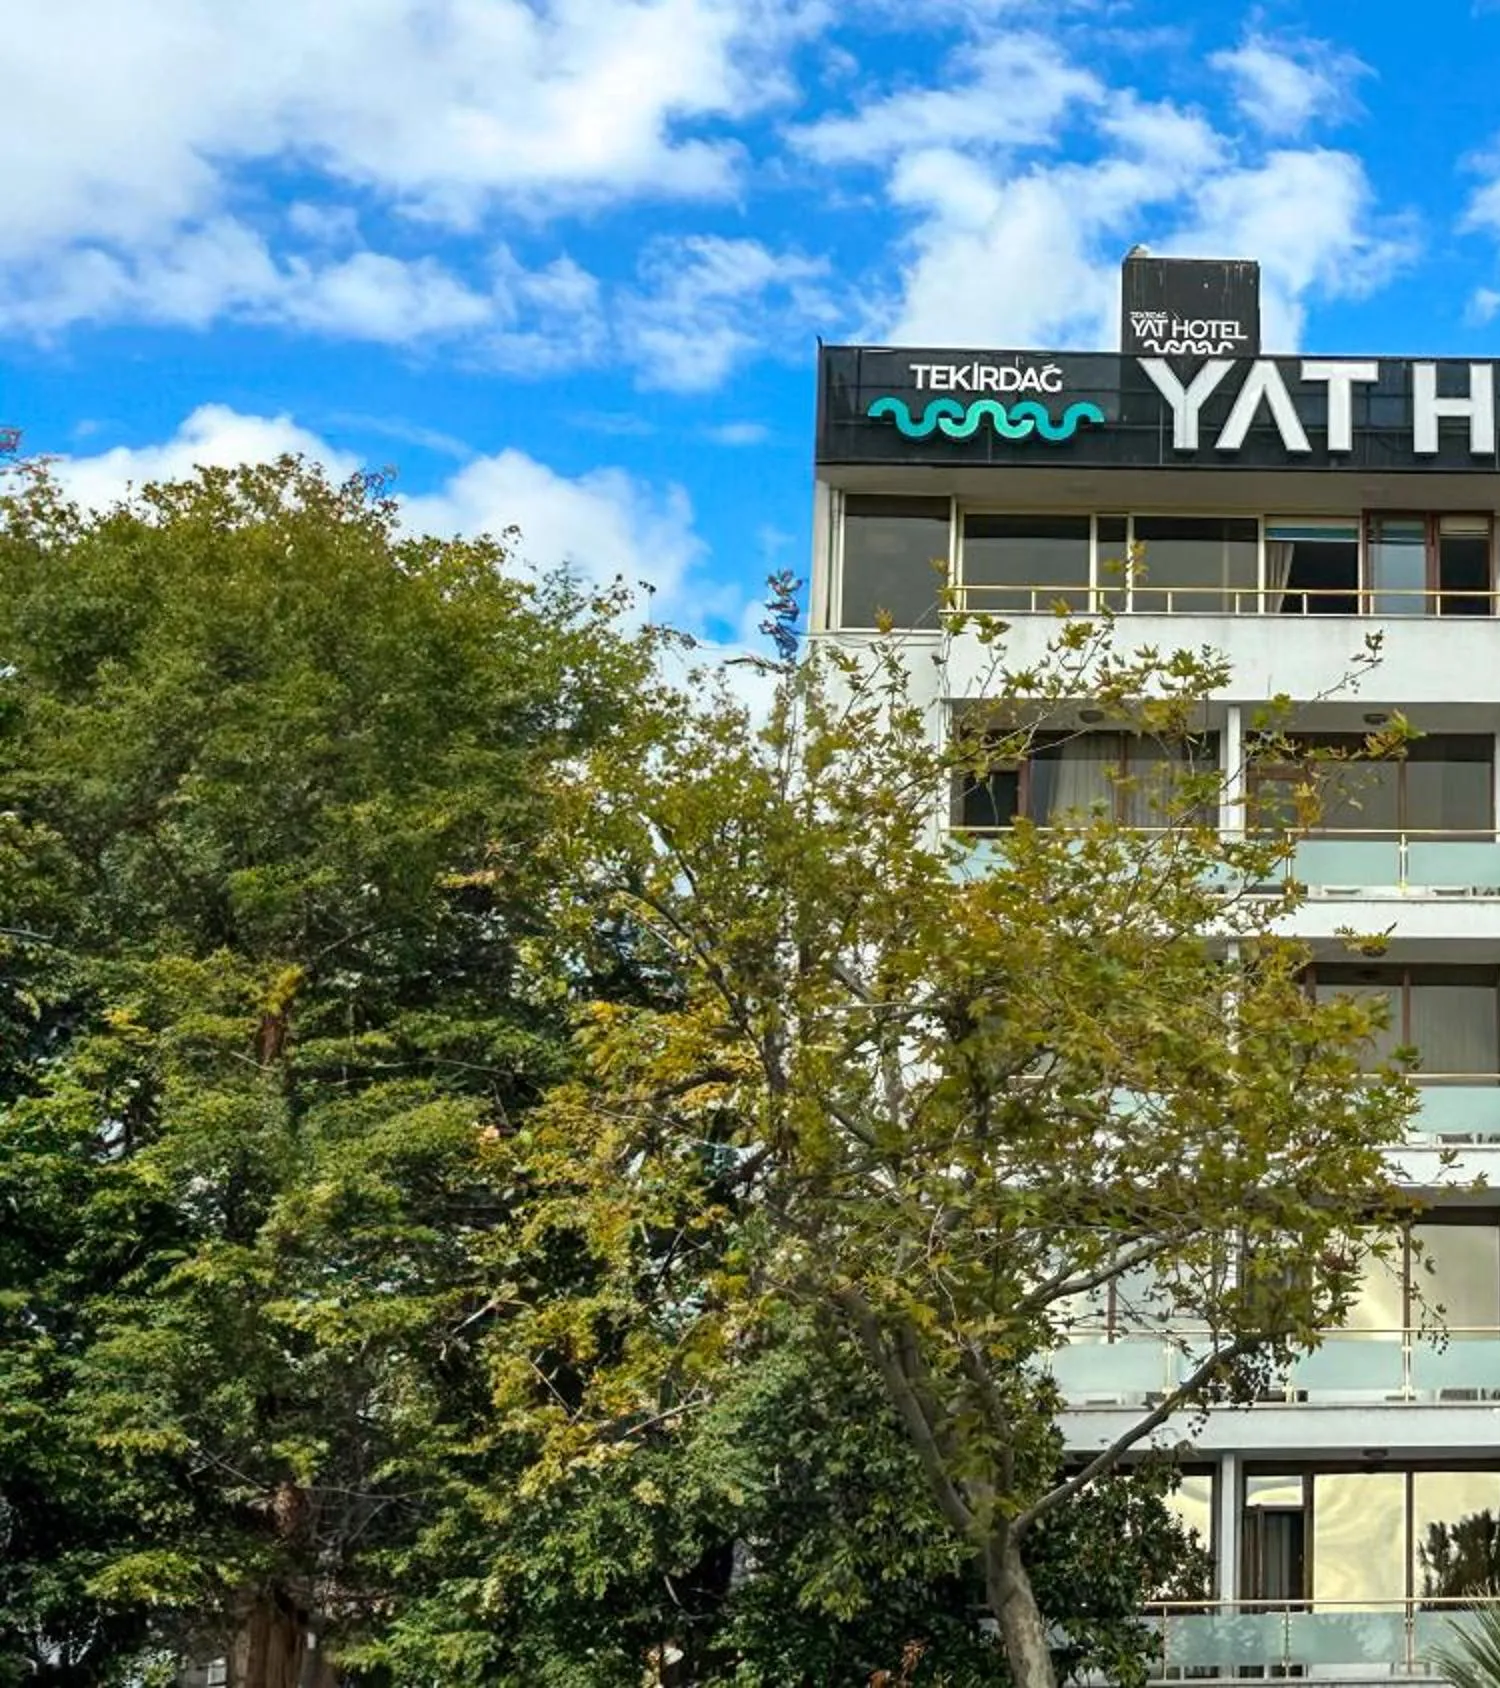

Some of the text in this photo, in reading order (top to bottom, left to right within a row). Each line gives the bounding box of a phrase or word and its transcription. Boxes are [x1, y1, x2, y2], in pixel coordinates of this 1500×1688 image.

[1131, 319, 1248, 339] YAT HOTEL
[910, 362, 1063, 392] TEKİRDAĞ
[1137, 358, 1379, 451] YAT
